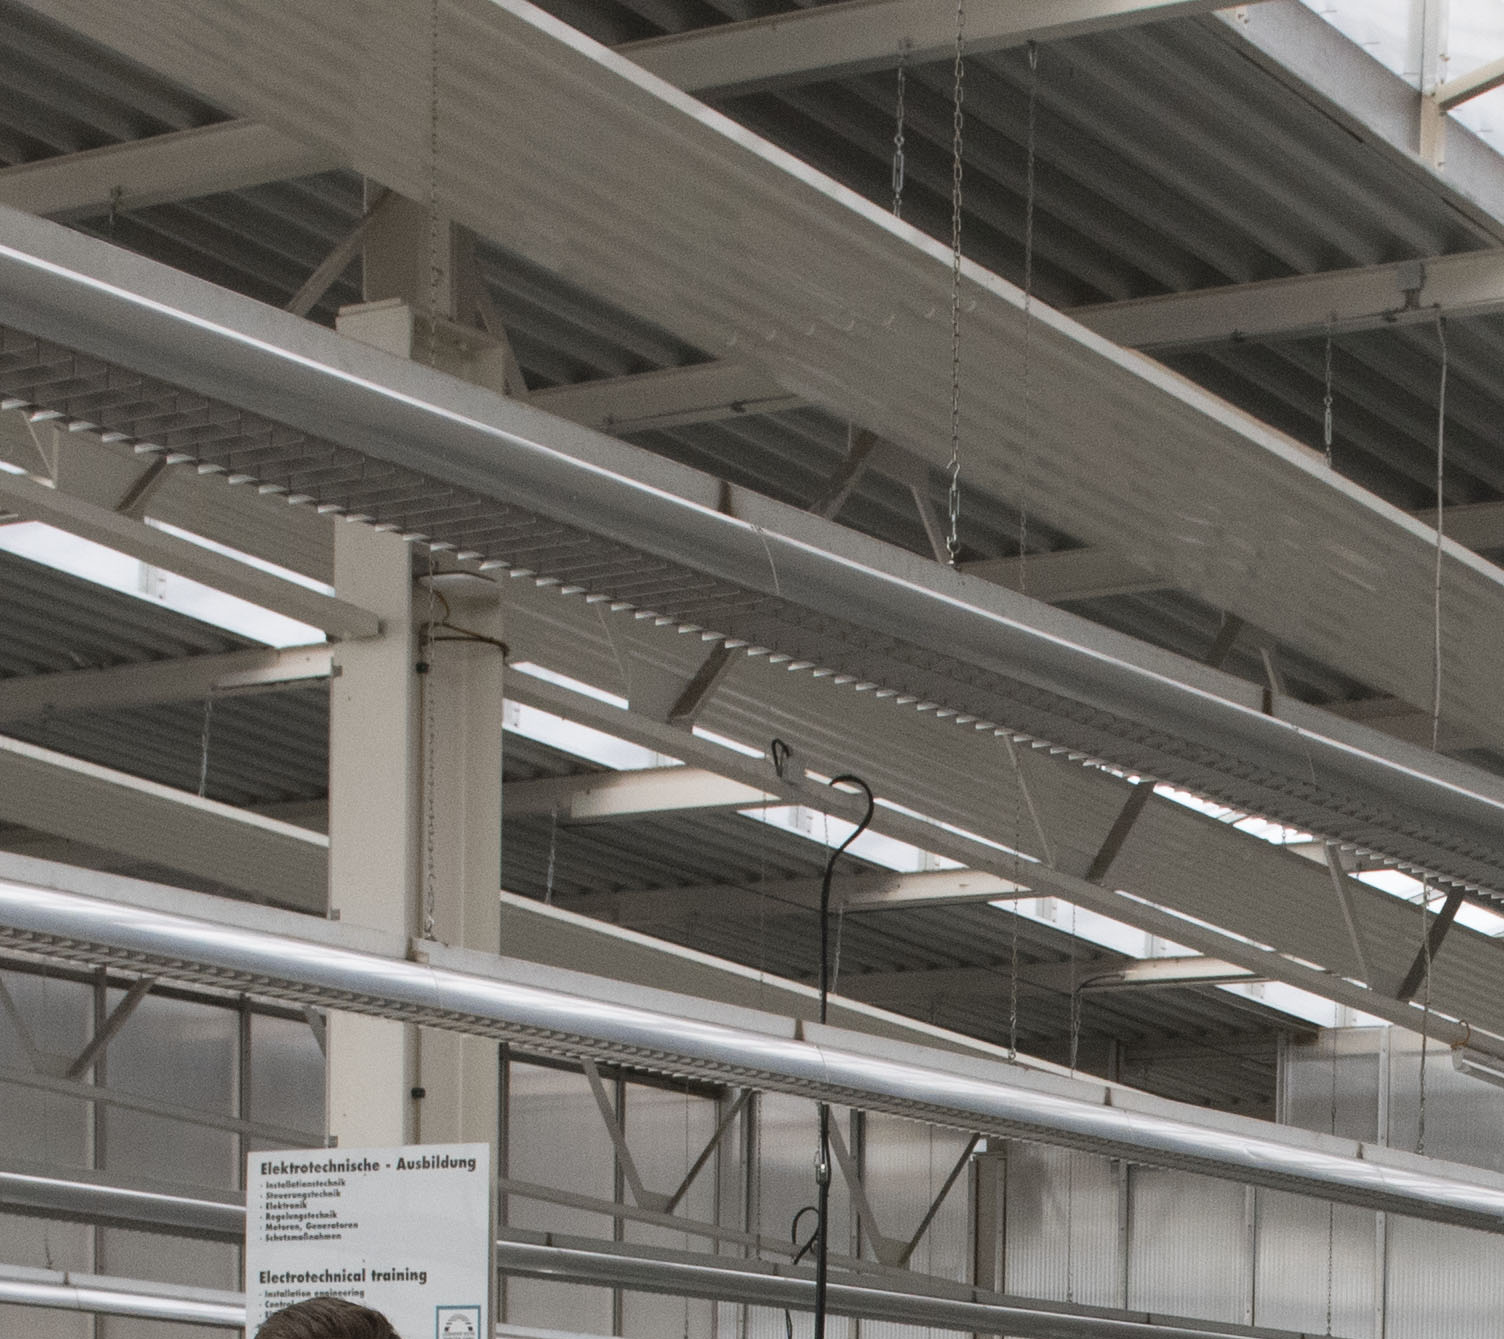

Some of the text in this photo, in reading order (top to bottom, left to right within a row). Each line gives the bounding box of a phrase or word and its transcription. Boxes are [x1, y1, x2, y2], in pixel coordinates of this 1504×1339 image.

[259, 1158, 380, 1175] Elektrotechnische
[396, 1155, 477, 1172] Ausbildung
[265, 1178, 346, 1188] Installationstechnik
[265, 1189, 341, 1200] Steuerungstechnik
[265, 1200, 307, 1210] Elektronik
[265, 1210, 337, 1222] Regelungstechnik
[265, 1221, 359, 1232] Motoren, Generatoren
[259, 1268, 427, 1285] Electrotechnical training
[264, 1288, 311, 1298] Installation
